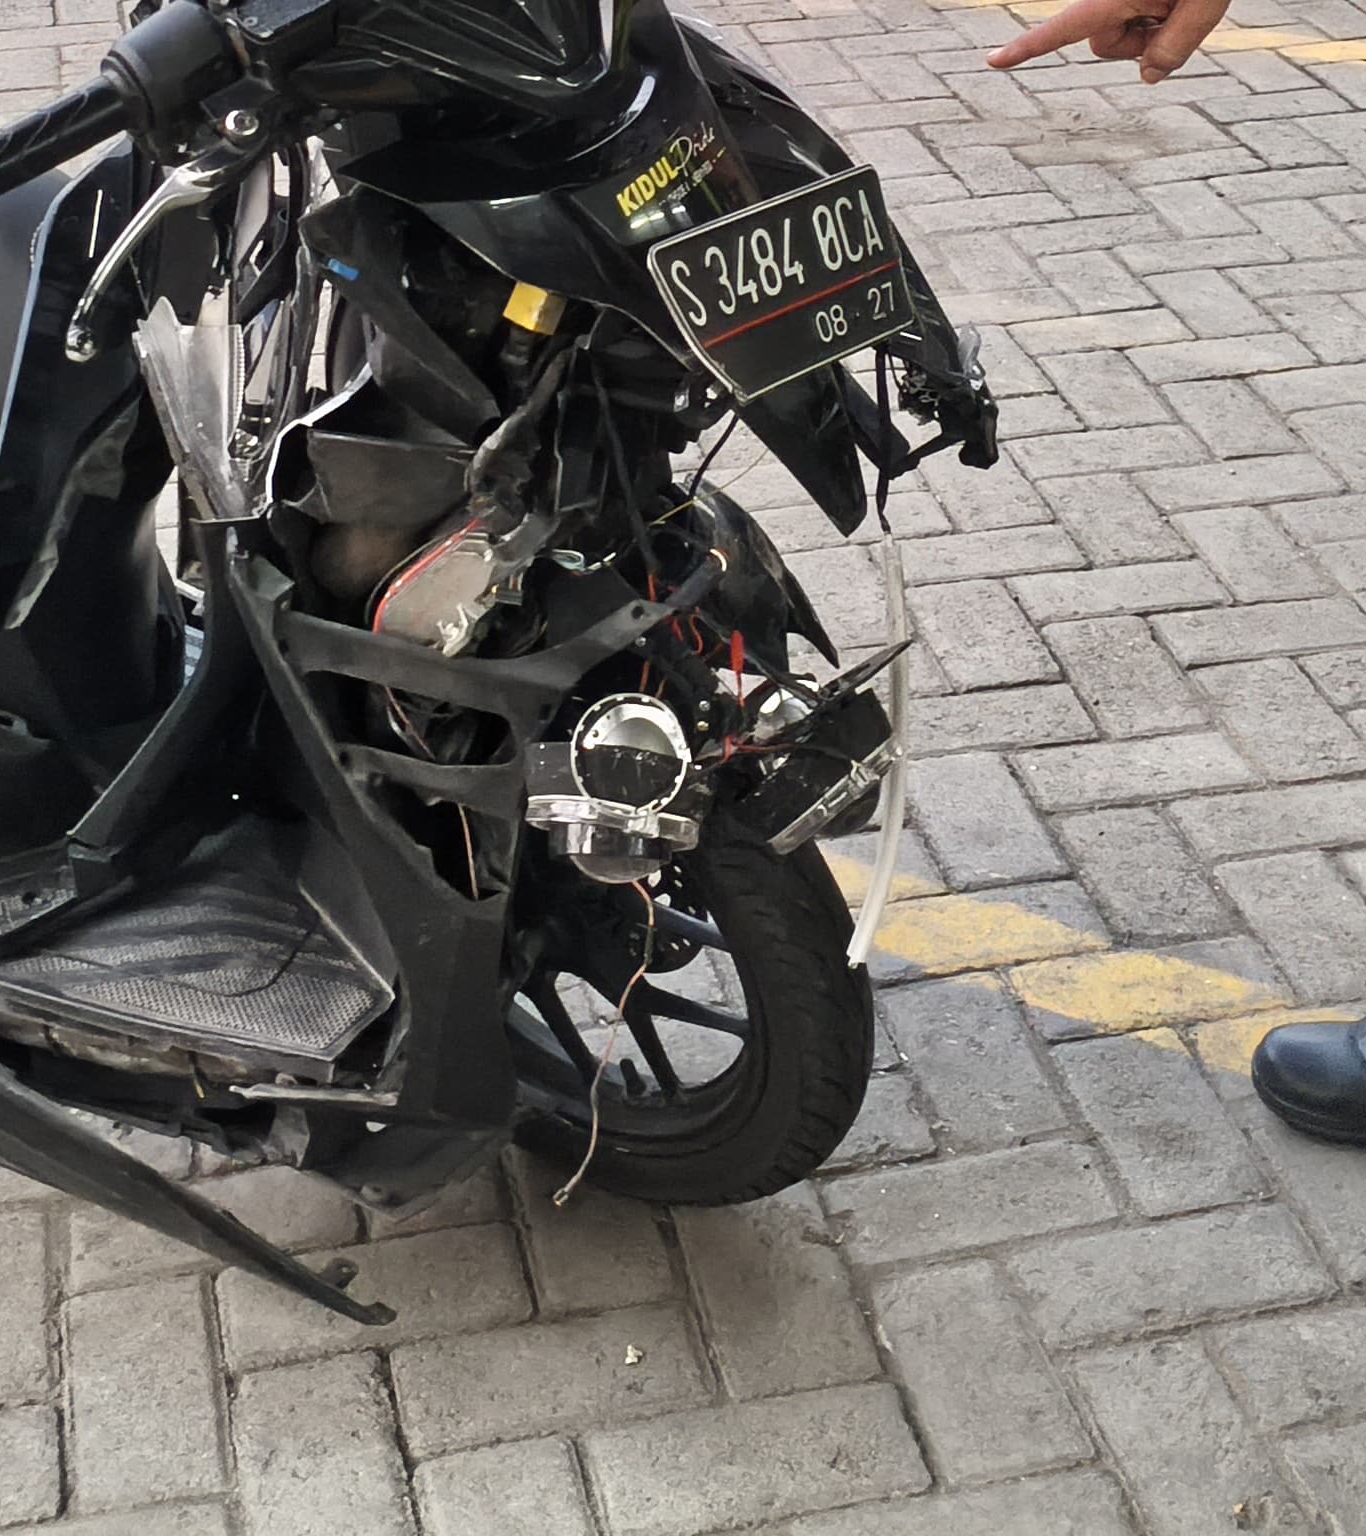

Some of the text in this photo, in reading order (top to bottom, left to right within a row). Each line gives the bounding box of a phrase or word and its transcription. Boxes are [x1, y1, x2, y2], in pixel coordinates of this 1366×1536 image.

[616, 156, 679, 217] KIDUL
[671, 260, 707, 327] S
[704, 217, 805, 315] 3484
